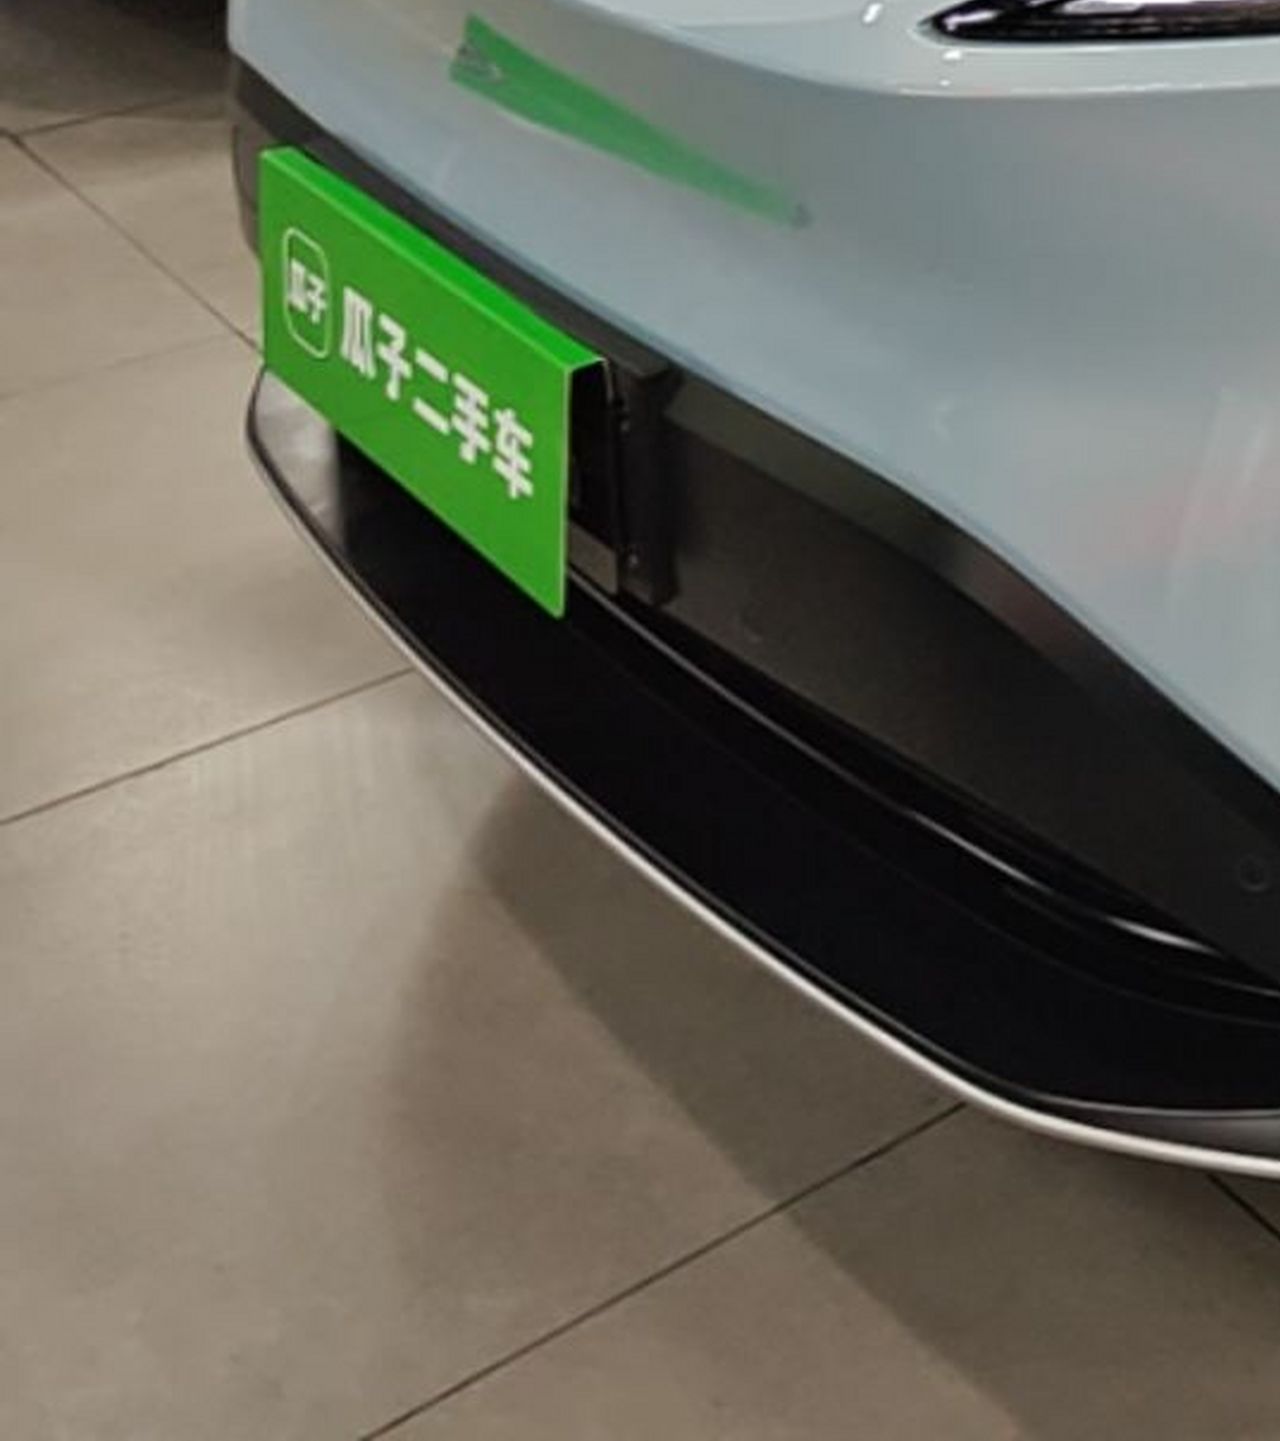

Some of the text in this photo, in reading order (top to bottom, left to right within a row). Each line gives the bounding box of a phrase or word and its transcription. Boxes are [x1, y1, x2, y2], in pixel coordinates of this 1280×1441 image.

[287, 258, 327, 324] 瓜子
[340, 285, 534, 500] 瓜子二手车
